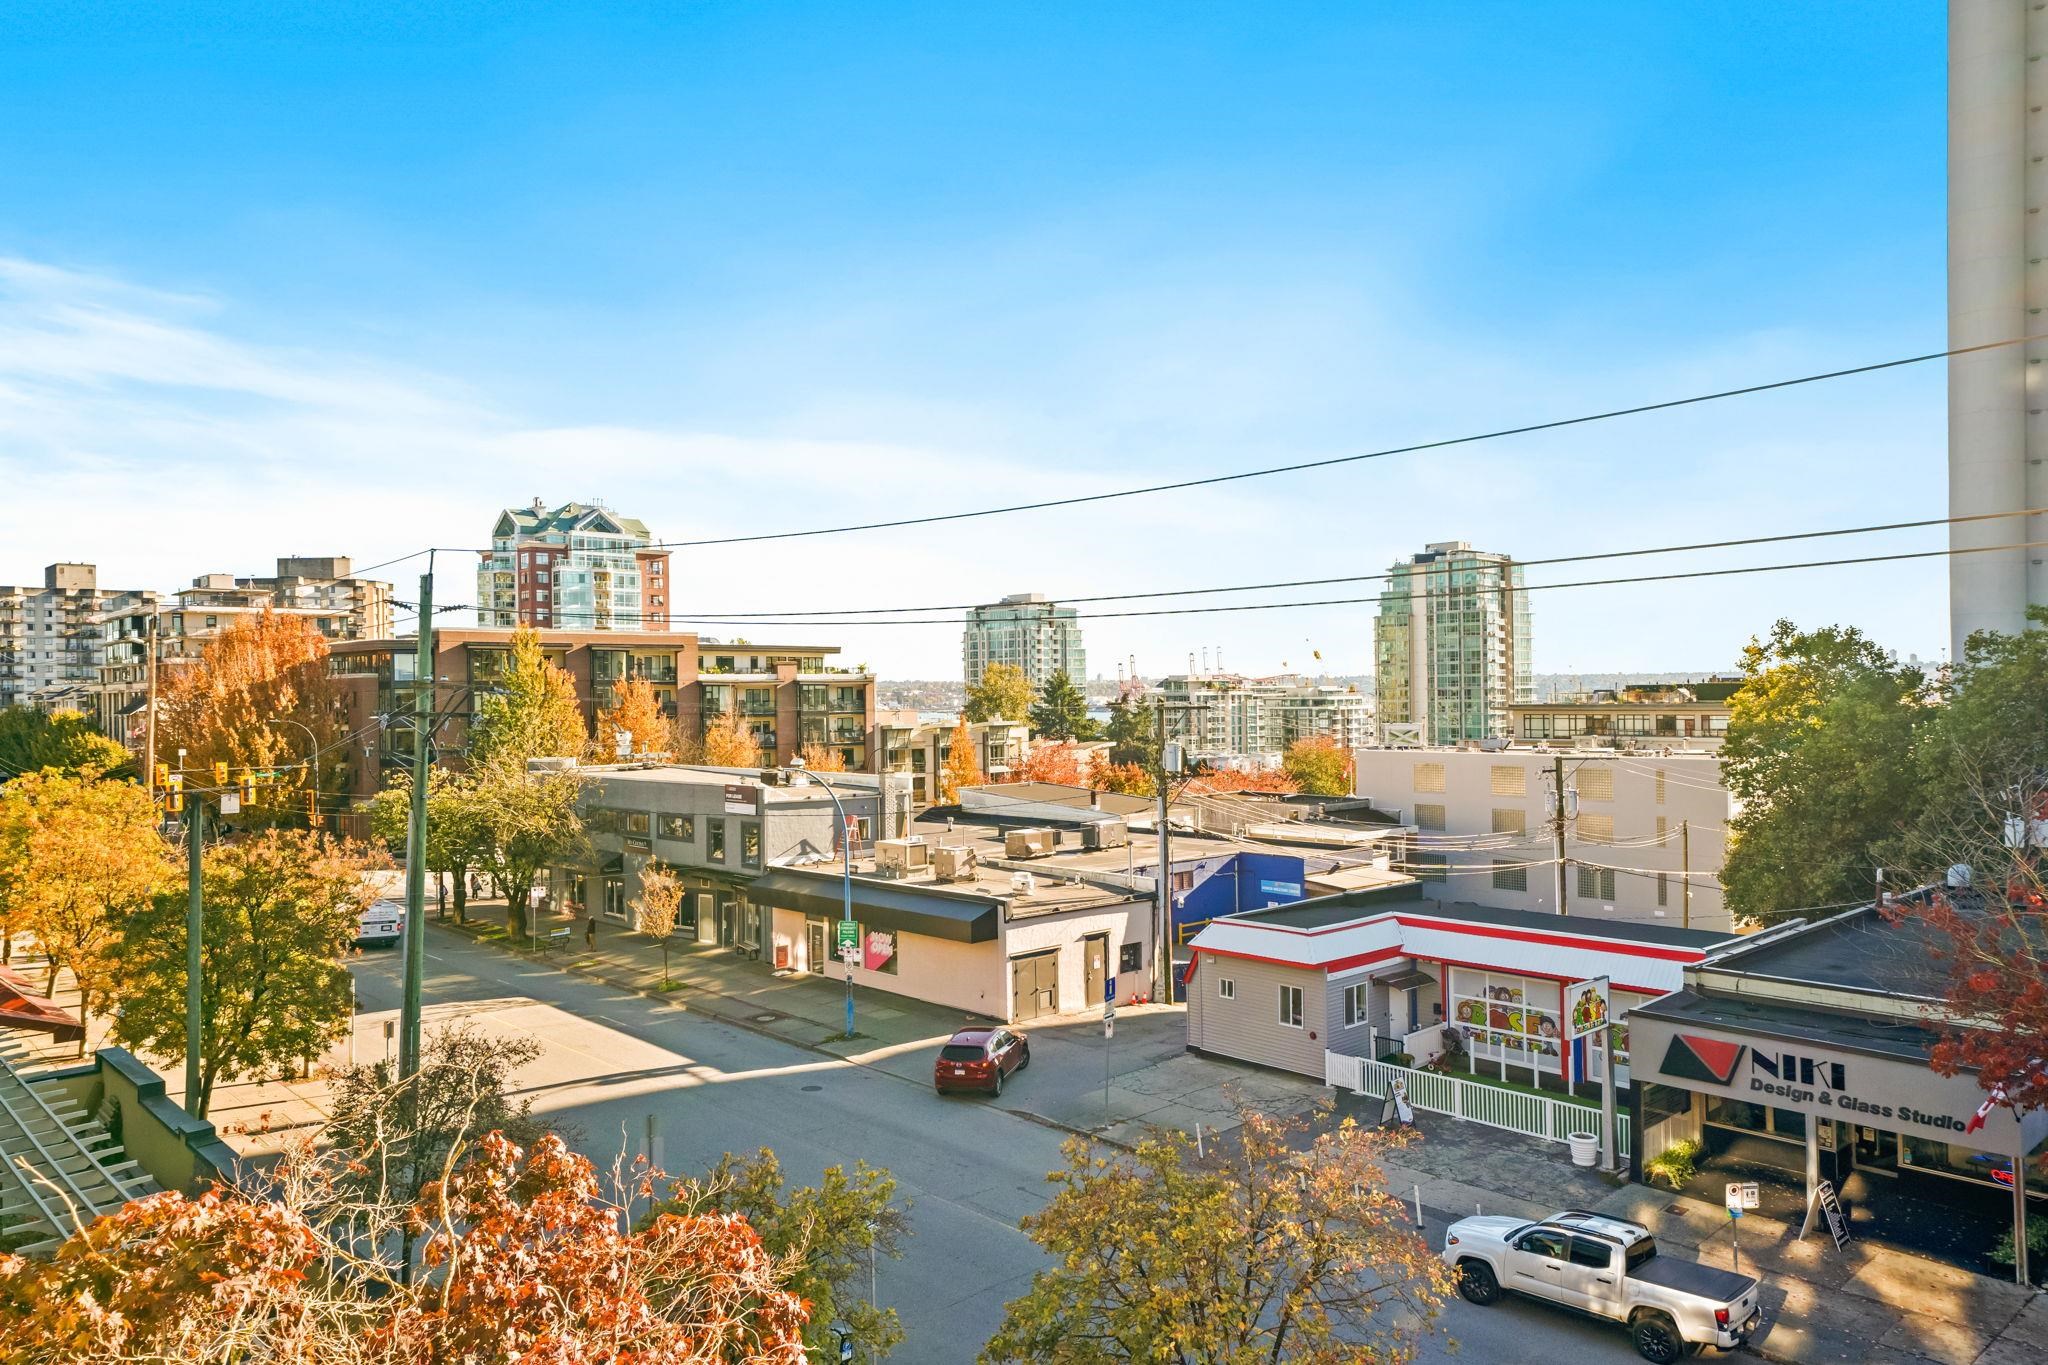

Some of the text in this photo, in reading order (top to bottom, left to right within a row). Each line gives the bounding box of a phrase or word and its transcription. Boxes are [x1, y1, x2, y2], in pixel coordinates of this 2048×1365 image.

[871, 931, 893, 943] NOW
[871, 942, 893, 955] OPEN
[1751, 1047, 1845, 1091] NIKI
[1750, 1077, 1966, 1132] Design & Glass Studio
